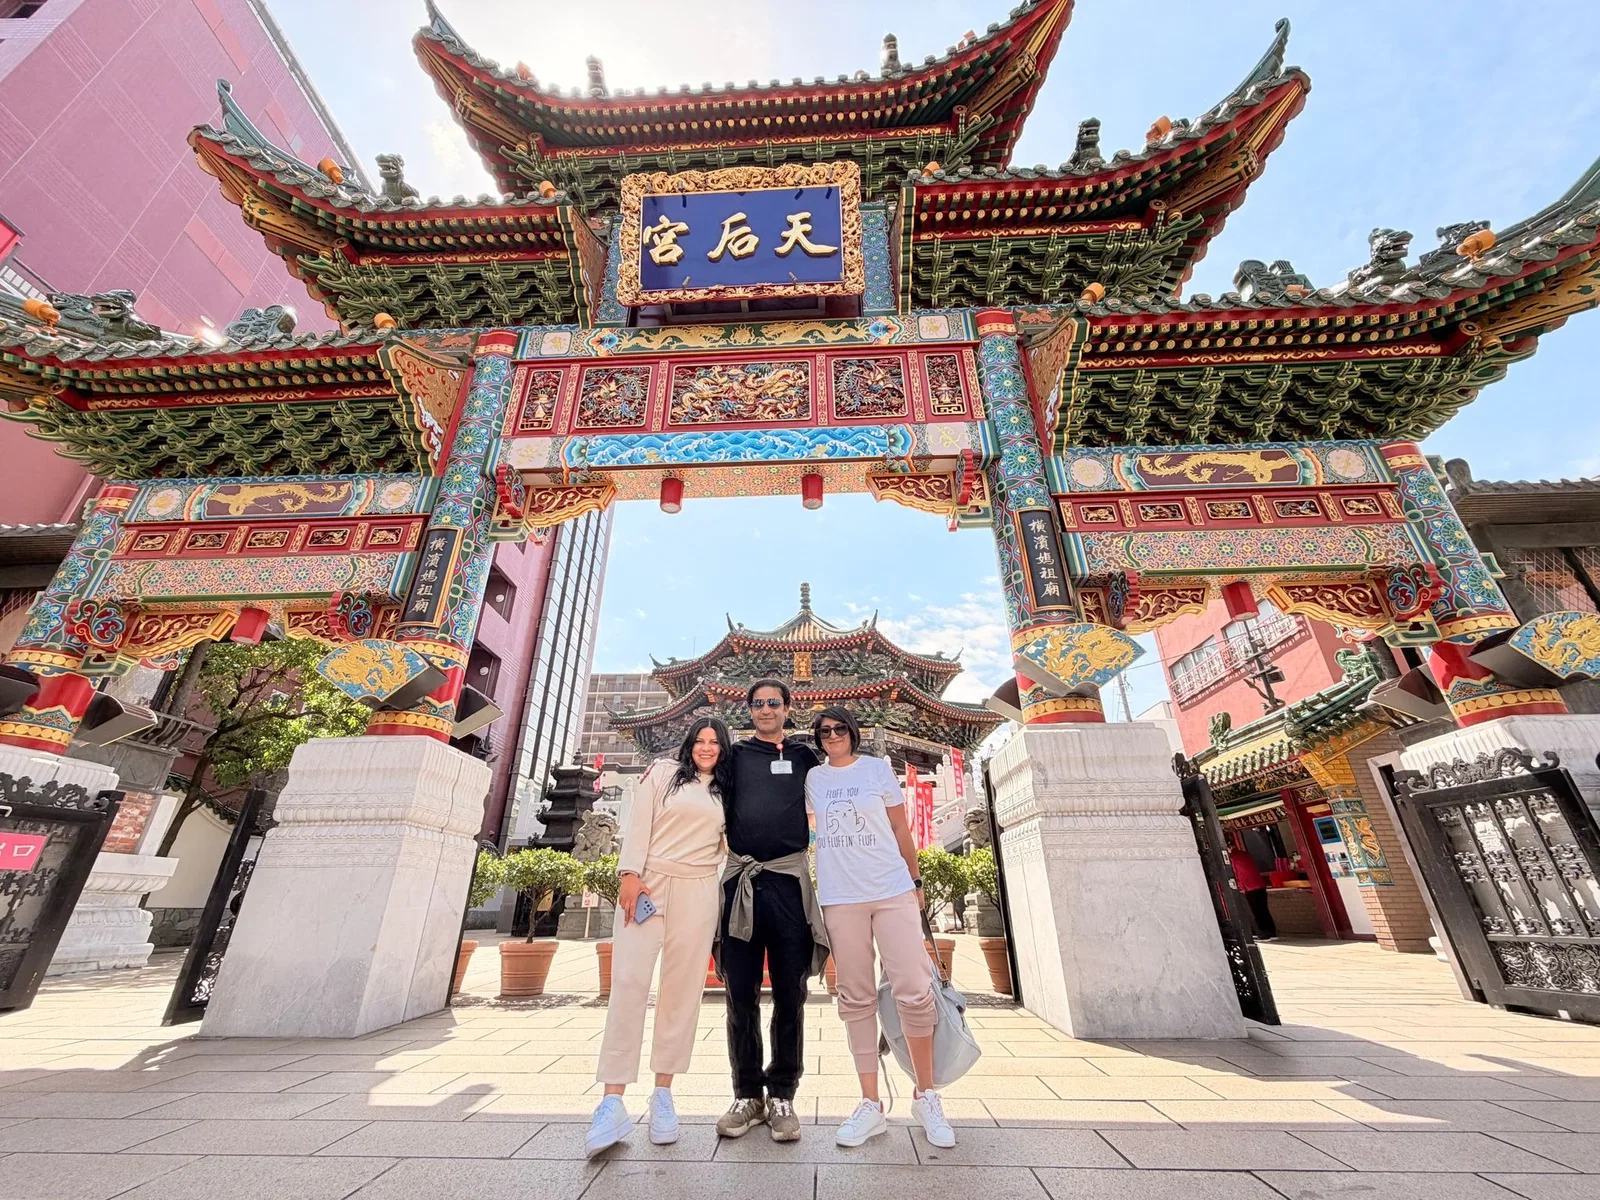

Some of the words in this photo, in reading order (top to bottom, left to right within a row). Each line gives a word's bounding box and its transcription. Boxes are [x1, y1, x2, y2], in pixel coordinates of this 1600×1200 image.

[826, 788, 843, 799] FLUFF
[847, 787, 859, 797] YOU
[817, 836, 826, 849] OU
[858, 834, 876, 847] FLUFF
